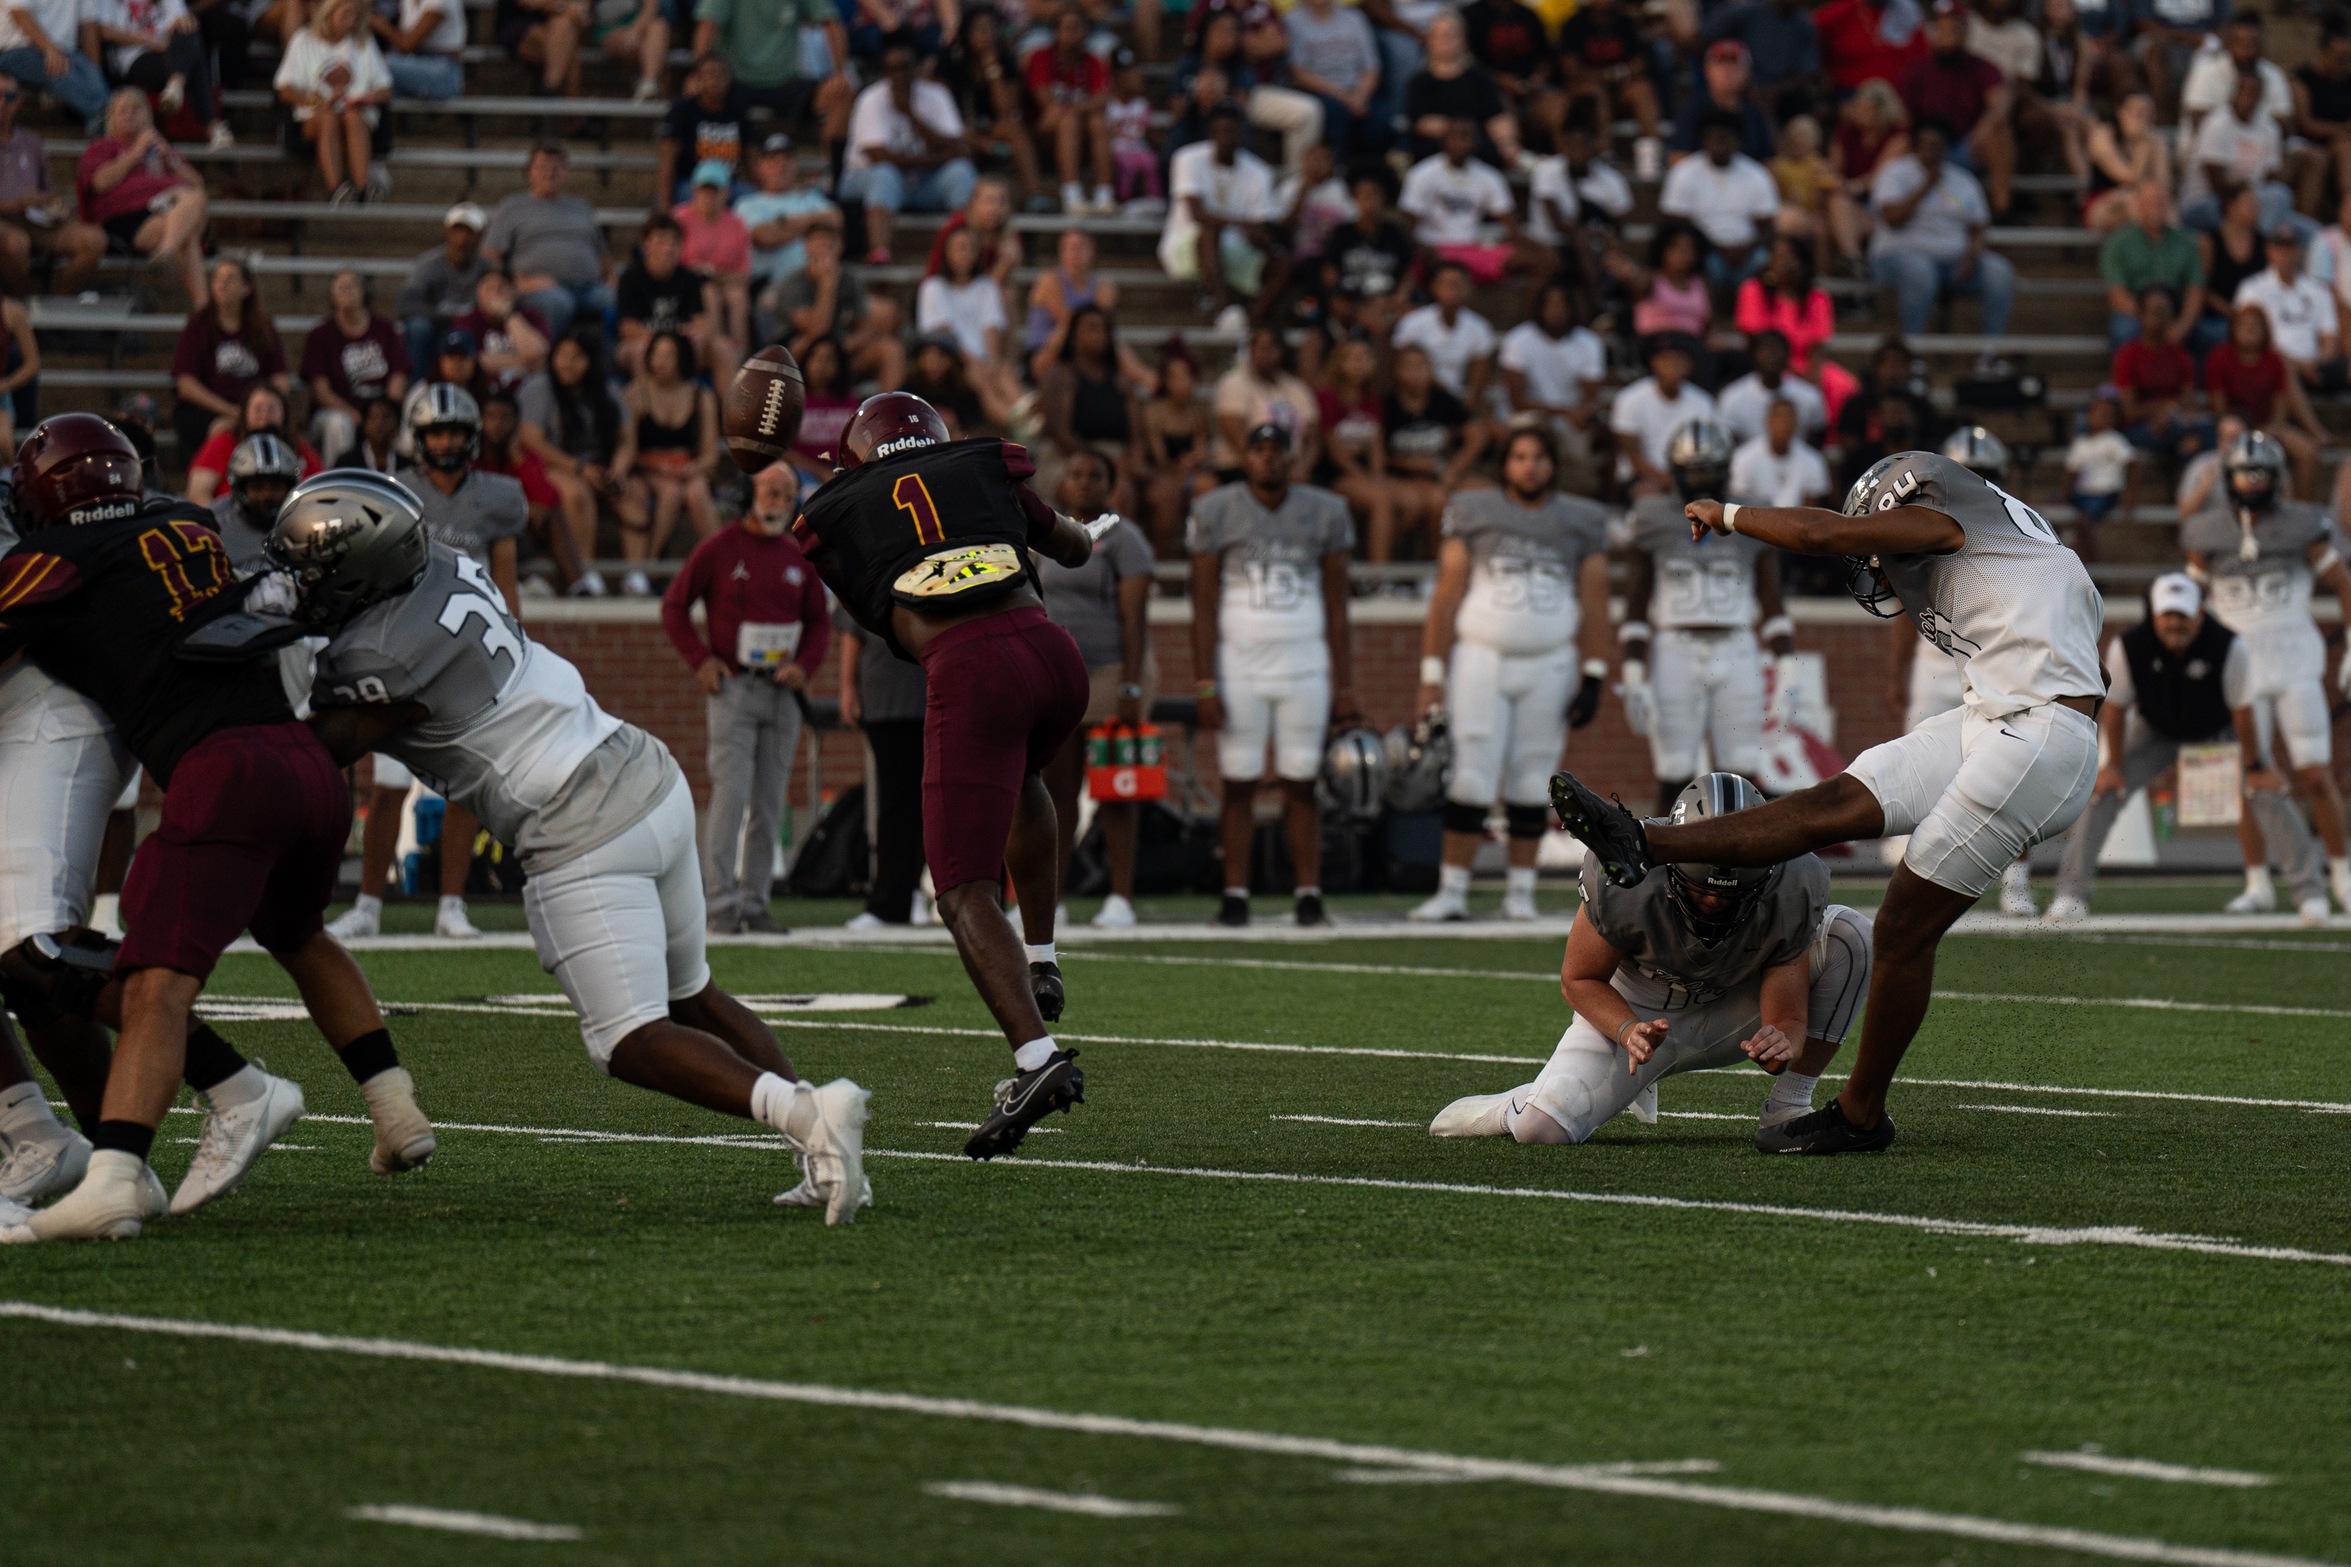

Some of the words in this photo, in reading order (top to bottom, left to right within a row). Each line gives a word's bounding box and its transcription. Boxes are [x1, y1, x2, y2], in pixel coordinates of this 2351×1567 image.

[69, 502, 136, 526] Riddell
[891, 472, 946, 547] 1
[1706, 876, 1739, 887] Riddell
